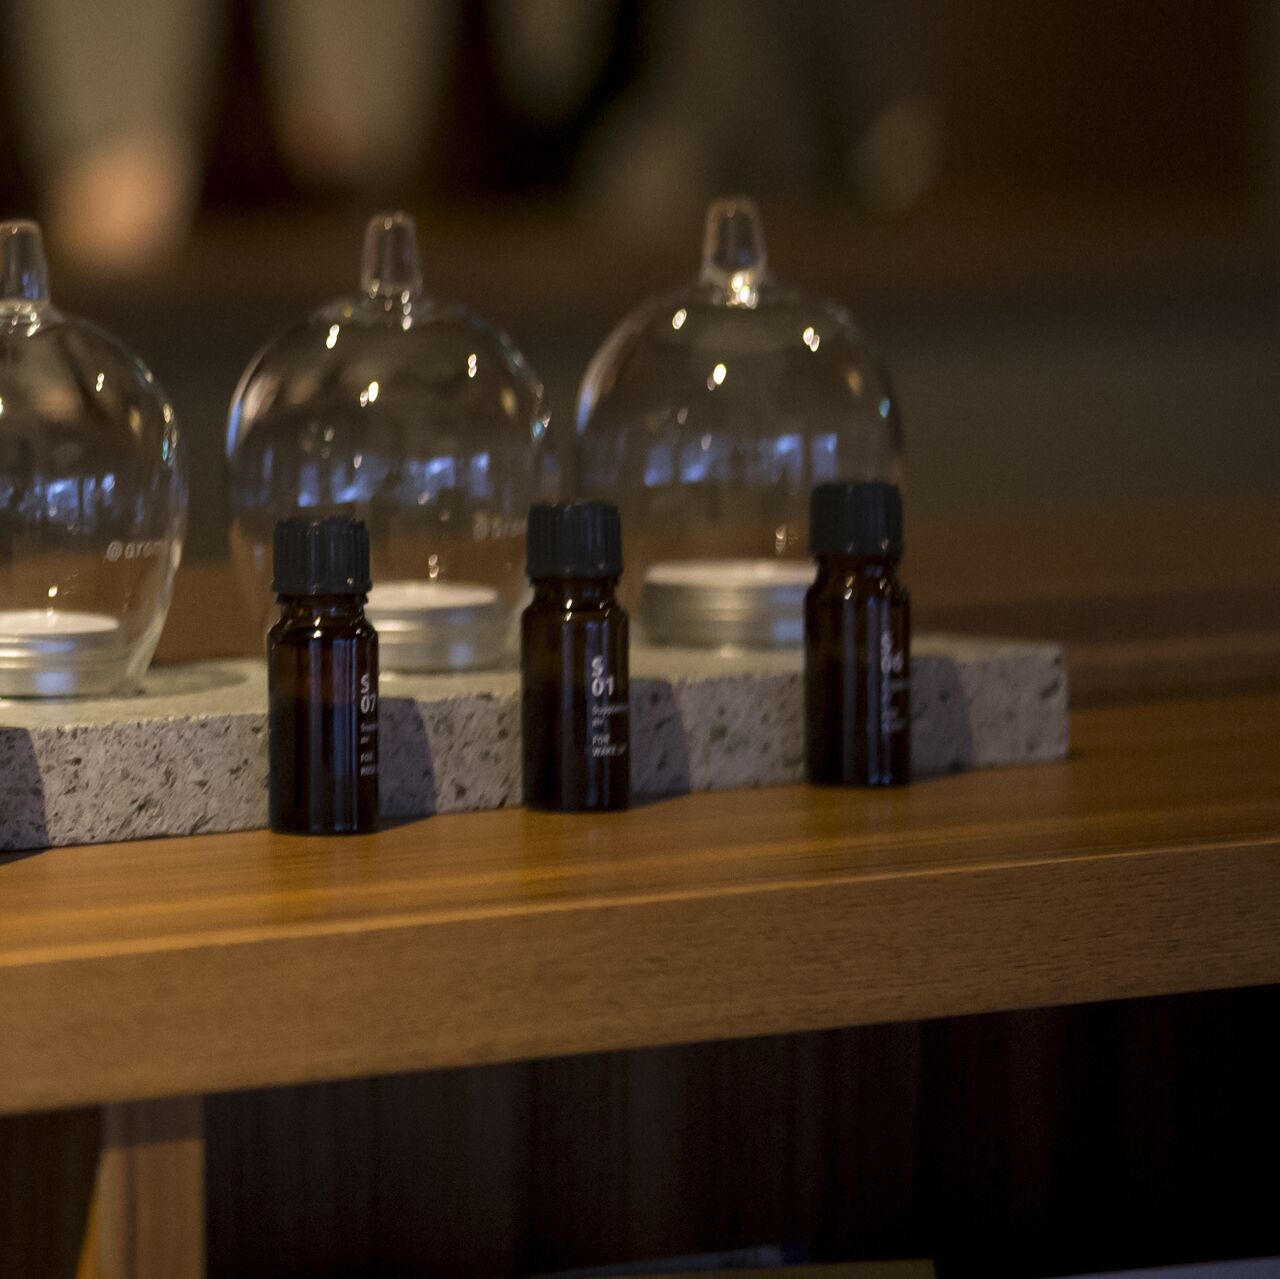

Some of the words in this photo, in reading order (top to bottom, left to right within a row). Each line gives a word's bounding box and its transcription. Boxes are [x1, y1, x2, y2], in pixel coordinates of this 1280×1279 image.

[591, 656, 604, 677] S
[360, 673, 370, 694] S
[591, 676, 615, 697] 01
[360, 694, 377, 714] 07
